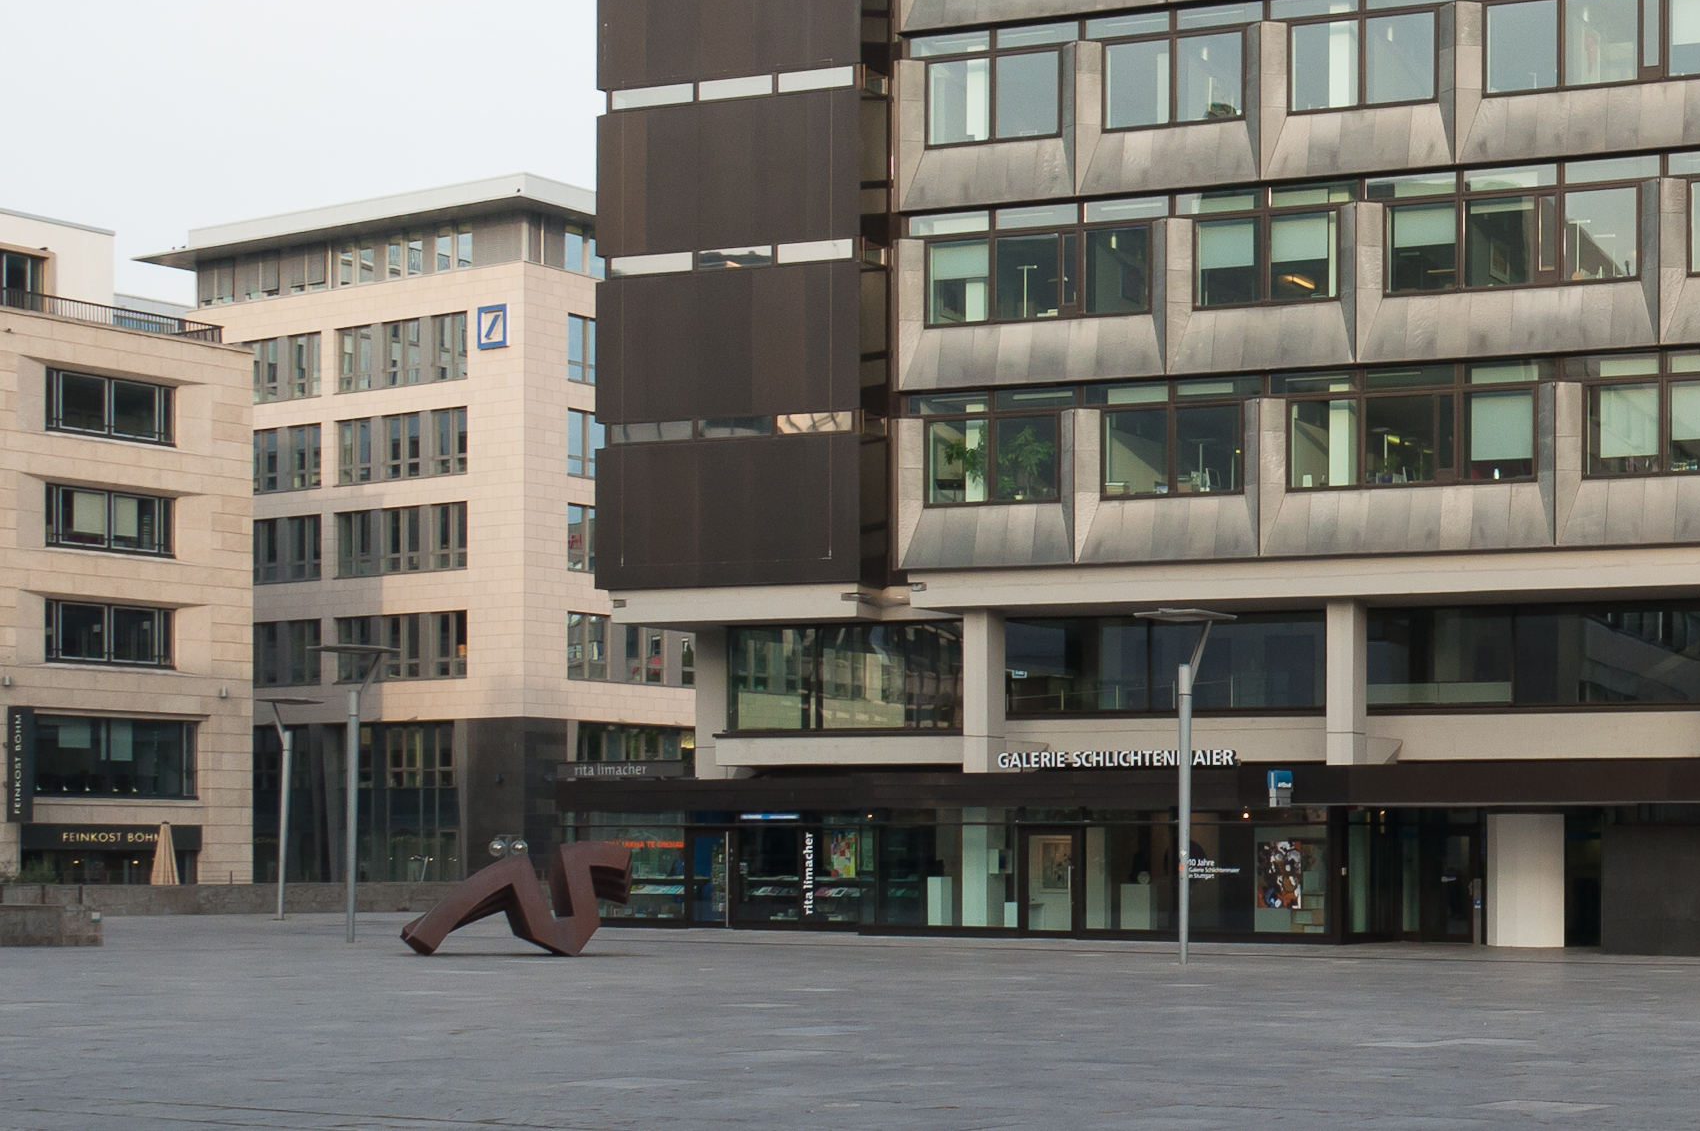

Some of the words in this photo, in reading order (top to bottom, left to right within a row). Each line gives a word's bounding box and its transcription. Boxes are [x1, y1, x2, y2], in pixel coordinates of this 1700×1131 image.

[14, 714, 22, 752] BÖHM
[574, 763, 595, 776] rita
[597, 762, 648, 776] limacher
[997, 751, 1067, 768] GALERIE
[14, 757, 22, 814] FEINKOST
[62, 832, 123, 843] FEINKOST
[803, 831, 814, 890] limacher
[803, 891, 814, 916] rita
